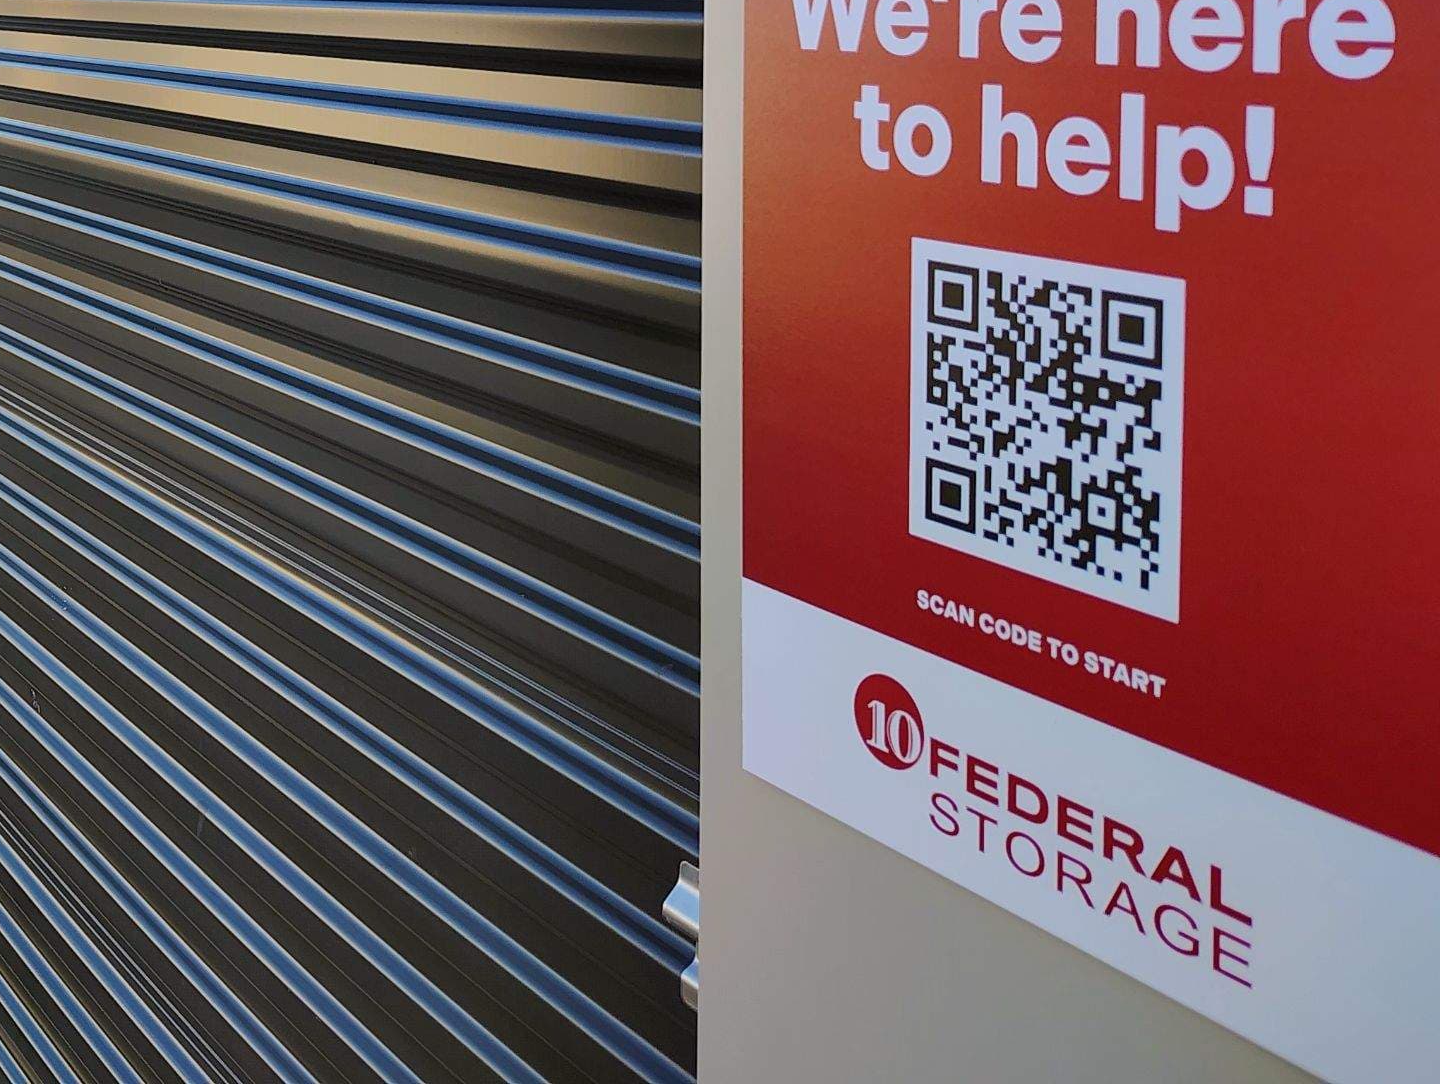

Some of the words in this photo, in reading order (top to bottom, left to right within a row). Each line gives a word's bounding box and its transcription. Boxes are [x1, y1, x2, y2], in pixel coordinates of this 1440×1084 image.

[853, 84, 953, 178] to
[980, 83, 1276, 233] help!
[916, 589, 975, 627] SCAN
[978, 613, 1042, 654] CODE
[1046, 637, 1080, 666] TO
[1084, 651, 1167, 699] START
[865, 699, 923, 765] 10
[929, 736, 1253, 927] FEDERAL
[929, 792, 1253, 989] STORAGE
